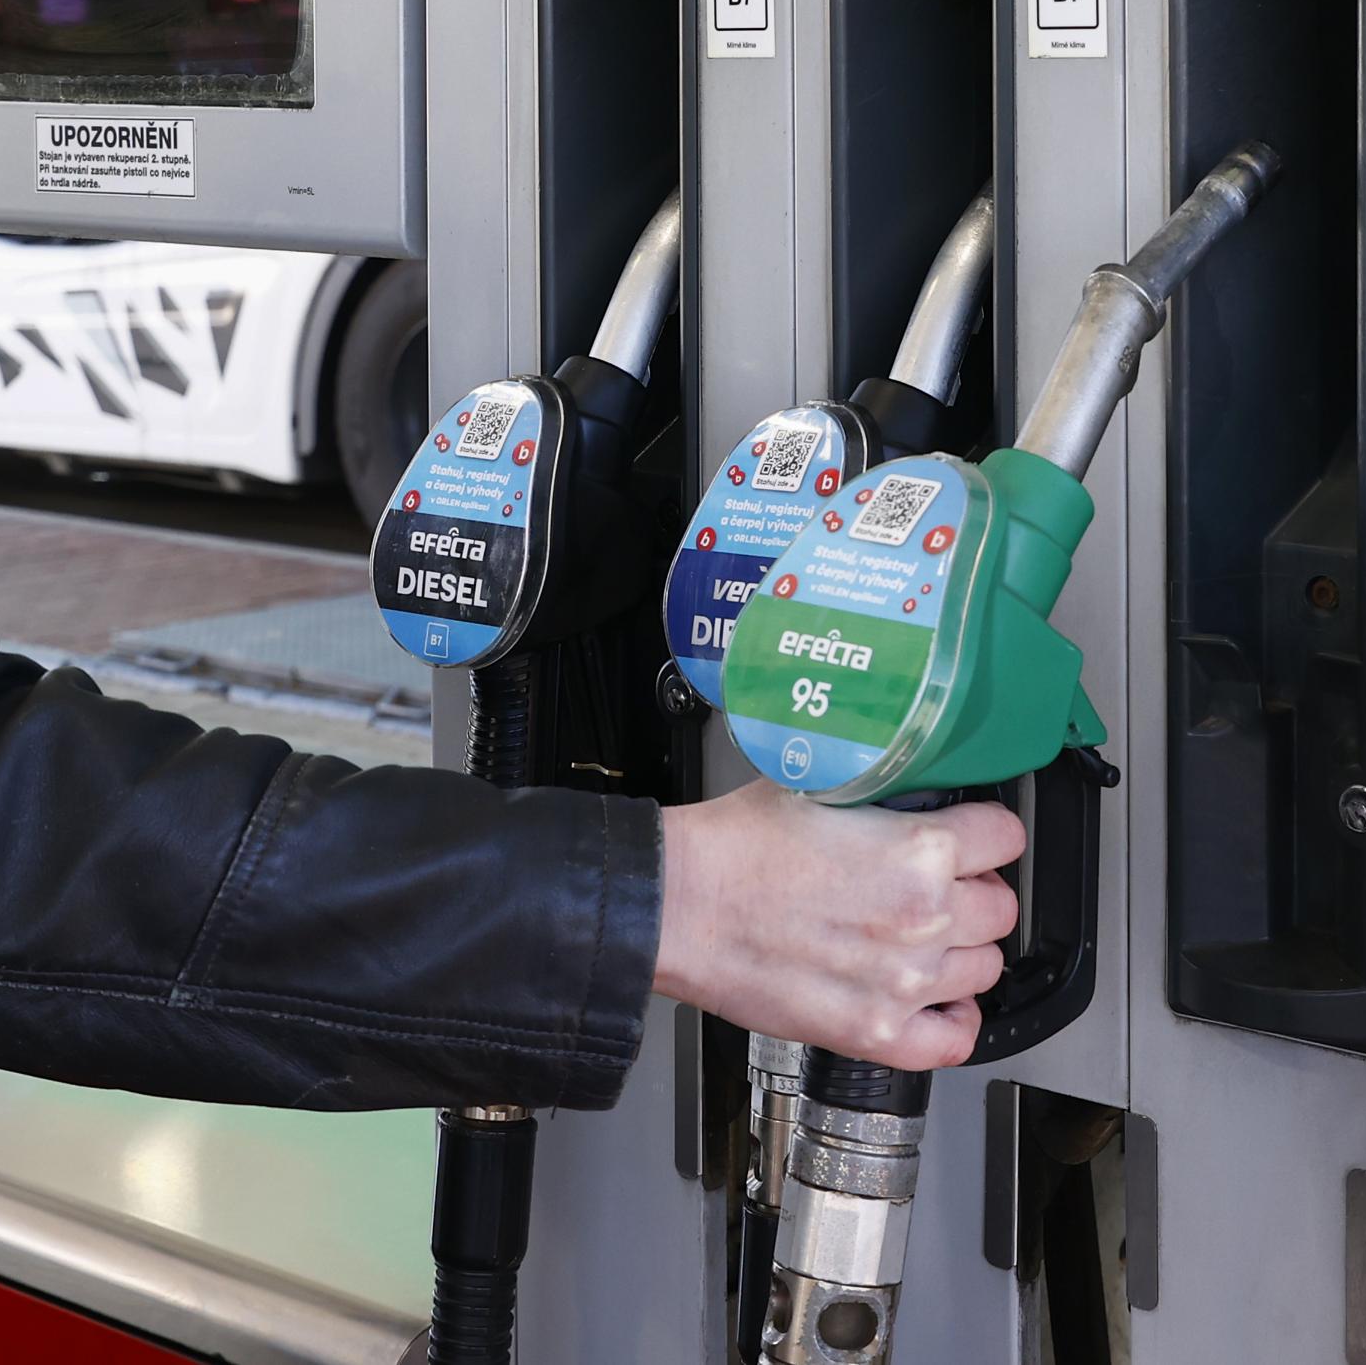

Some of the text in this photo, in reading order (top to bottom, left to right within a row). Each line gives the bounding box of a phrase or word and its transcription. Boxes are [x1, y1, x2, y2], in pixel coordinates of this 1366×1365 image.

[51, 122, 178, 150] UPOZORNĚNÍ
[39, 151, 191, 164] Stojan je vybaven rekuperací 2. stupně.
[39, 165, 50, 173] Při
[52, 165, 88, 175] tankování
[91, 166, 120, 175] zasuňte
[123, 167, 147, 177] pistoli
[162, 168, 190, 179] nejvíce
[40, 178, 100, 188] do hrdla nádrže.
[288, 186, 315, 196] Vmin=5L
[430, 464, 511, 485] Stahuj, registruj
[756, 478, 776, 487] Stahuj
[426, 480, 504, 500] a čerpej výhody
[436, 498, 459, 506] ORLEN
[461, 501, 490, 512] aplikaci
[725, 499, 815, 519] Stahuj, registruj
[730, 515, 765, 531] čerpej
[768, 520, 804, 533] výhod
[410, 527, 486, 561] efecta
[734, 534, 760, 544] ORLEN
[813, 545, 919, 576] Stahuj, registruj
[805, 563, 907, 592] a čerpej výhody
[397, 567, 487, 608] DIESEL
[713, 579, 760, 603] ver
[817, 585, 848, 597] ORLEN
[431, 634, 442, 646] B7
[778, 629, 873, 671] efecta
[791, 678, 832, 717] 95
[786, 750, 807, 767] E10
